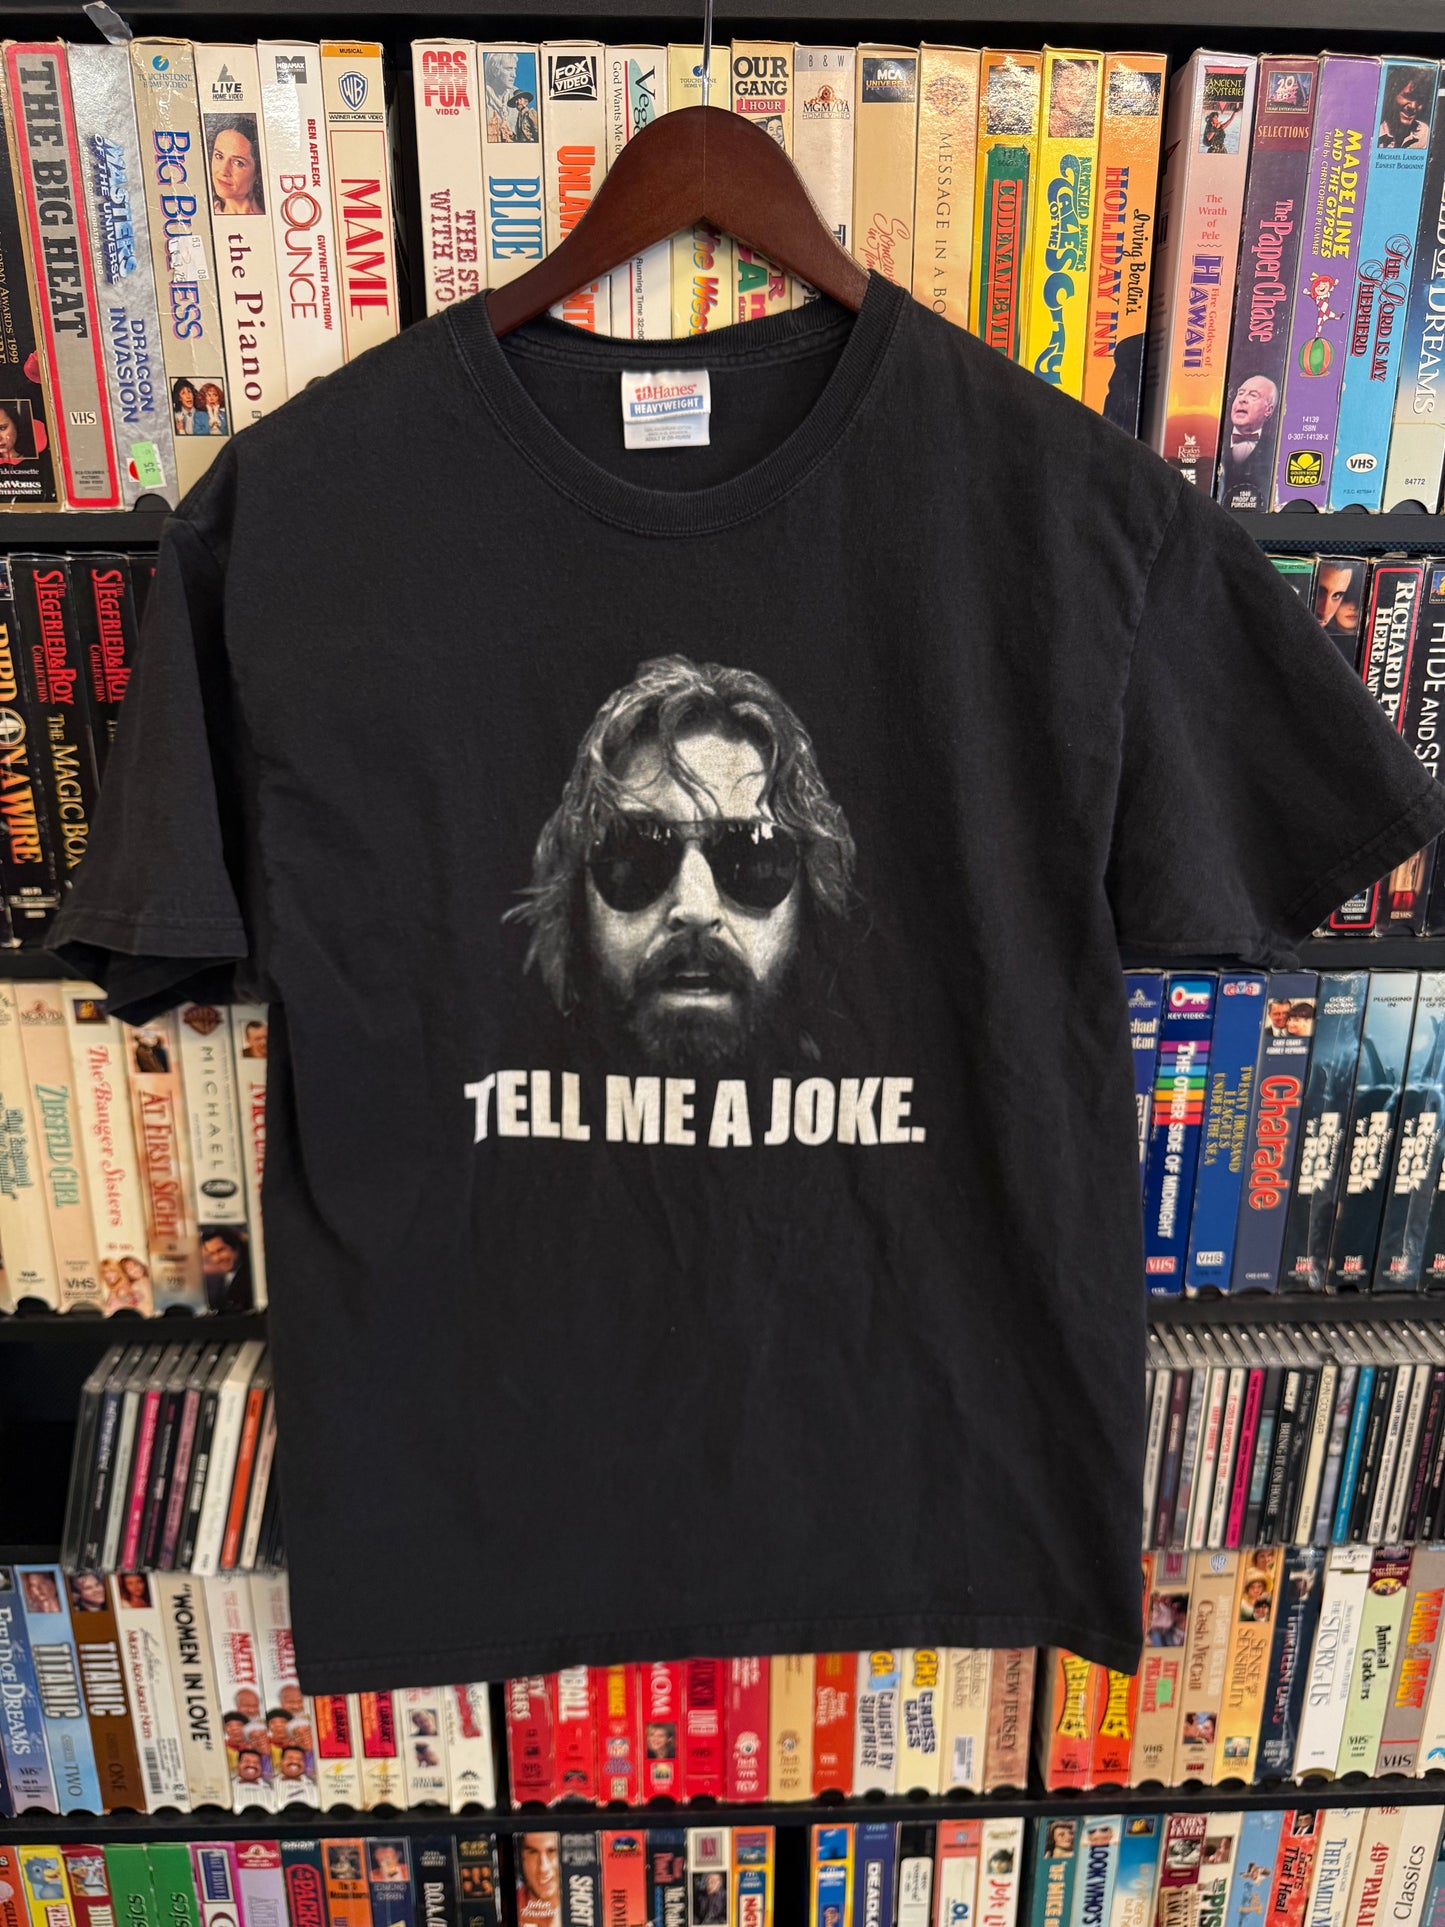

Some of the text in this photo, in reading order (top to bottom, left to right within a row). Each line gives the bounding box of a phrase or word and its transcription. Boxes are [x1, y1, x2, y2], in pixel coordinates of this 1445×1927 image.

[212, 82, 242, 93] LIVE
[556, 60, 588, 80] FOX
[556, 75, 589, 91] VIDEO
[612, 61, 623, 118] God Wants
[733, 56, 790, 79] OUR
[735, 81, 788, 96] GANG
[877, 69, 903, 80] MCA
[1205, 86, 1244, 97] MYSTERIES
[1209, 79, 1242, 88] ANCIENT
[750, 101, 782, 110] HOUR
[803, 102, 850, 113] MGM/UA
[1257, 125, 1310, 139] SELECTIONS
[153, 130, 191, 186] BIG
[307, 118, 321, 187] BEN AFFLECK
[1377, 153, 1401, 161] MICHAEL
[20, 60, 88, 338] THE BIG HEAT
[103, 138, 137, 278] MASTERS
[489, 175, 544, 260] BLUE
[935, 131, 954, 260] MESSAGE IN
[1199, 206, 1227, 216] Wrath
[1205, 194, 1223, 203] The
[1311, 159, 1329, 256] CHRISTOPHER PLUMMER
[1320, 128, 1345, 260] AND THE GYPSIES
[1332, 129, 1363, 259] MADELINE
[103, 203, 121, 286] UNIVERSE
[279, 174, 322, 319] BOUNCE
[341, 179, 390, 321] MAME
[430, 189, 454, 260] WITH
[455, 209, 478, 262] THE
[1201, 231, 1220, 240] Pele
[1207, 218, 1216, 228] of
[317, 234, 333, 330] GWYNETH PALTROW
[1093, 166, 1130, 358] HOLIDAY INN
[1125, 260, 1147, 317] Berlin's
[228, 233, 264, 402] the Piano
[1034, 272, 1075, 385] CITY
[1182, 254, 1224, 368] HAWAII
[1206, 288, 1220, 355] Fire Goddess
[1248, 283, 1288, 343] Chase
[8, 337, 19, 364] 1999
[107, 306, 140, 423] INVASION
[130, 318, 154, 412] DRAGON
[71, 411, 96, 425] VHS
[634, 398, 699, 415] HEAVYWEIGHT
[652, 385, 695, 400] Hanes
[1302, 416, 1320, 424] 14139
[1289, 475, 1319, 485] VIDEO
[1349, 459, 1374, 470] VHS
[1370, 607, 1394, 663] HERE
[1384, 581, 1417, 688] RICHARD
[32, 645, 49, 702] COLLECTION
[1417, 697, 1440, 741] AND
[48, 713, 86, 822] THE MAGIC
[1, 785, 43, 865] WIRE
[1168, 1013, 1182, 1021] KEY
[202, 1045, 225, 1170] MICHAEL
[464, 1069, 927, 1148] TELL ME A JOKE.
[35, 1084, 81, 1209] ZIEGFELD GIRL
[92, 1082, 126, 1228] Banger Sisters
[142, 1090, 180, 1240] AT FIRST SIGHT
[1157, 1041, 1197, 1240] THE OTHER SIDE OF MIDNIGHT
[1228, 1113, 1249, 1173] THOUSAND
[1249, 1075, 1301, 1210] Charade
[1298, 1137, 1319, 1194] ROLL
[1313, 1112, 1340, 1191] ROCK
[1346, 1137, 1369, 1194] ROLL
[1362, 1112, 1389, 1191] ROCK
[1394, 1137, 1417, 1194] ROLL
[1410, 1112, 1437, 1191] ROCK
[66, 1278, 97, 1289] VHS
[1148, 1259, 1176, 1272] VHS
[1197, 1253, 1223, 1264] VHS
[1285, 1371, 1301, 1413] UNCUT
[1315, 1371, 1334, 1436] JOHN COUGAR
[1275, 1422, 1292, 1455] BRING
[1267, 1484, 1282, 1516] HOME
[1271, 1467, 1285, 1484] ON
[1407, 1588, 1445, 1644] YEARS
[1189, 1600, 1214, 1690] Cash McCall
[1229, 1628, 1254, 1709] SENSIBILITY
[1251, 1638, 1267, 1680] SENSE
[1308, 1614, 1341, 1707] STORY US
[1376, 1625, 1392, 1669] Animal
[184, 1673, 205, 1690] IN
[1361, 1648, 1377, 1700] Crackers
[1395, 1657, 1431, 1708] BEAST
[1, 1683, 31, 1755] DREAMS
[33, 1642, 83, 1719] TITANIC
[64, 1763, 83, 1797] TWO
[79, 1641, 127, 1793] TITANIC ONE
[859, 1694, 877, 1767] SURPRISE
[876, 1691, 894, 1770] CAUGHT BY
[1001, 1660, 1021, 1752] NEW JERSEY
[1143, 1744, 1163, 1753] VHS
[1349, 1735, 1369, 1744] VHS
[1383, 1756, 1413, 1767] VHS
[568, 1874, 595, 1927] SHORT
[1082, 1845, 1110, 1925] LOOK WHO'S
[1274, 1846, 1299, 1914] That Heal
[1313, 1838, 1348, 1915] THE FAMILY
[1394, 1845, 1425, 1920] Classics
